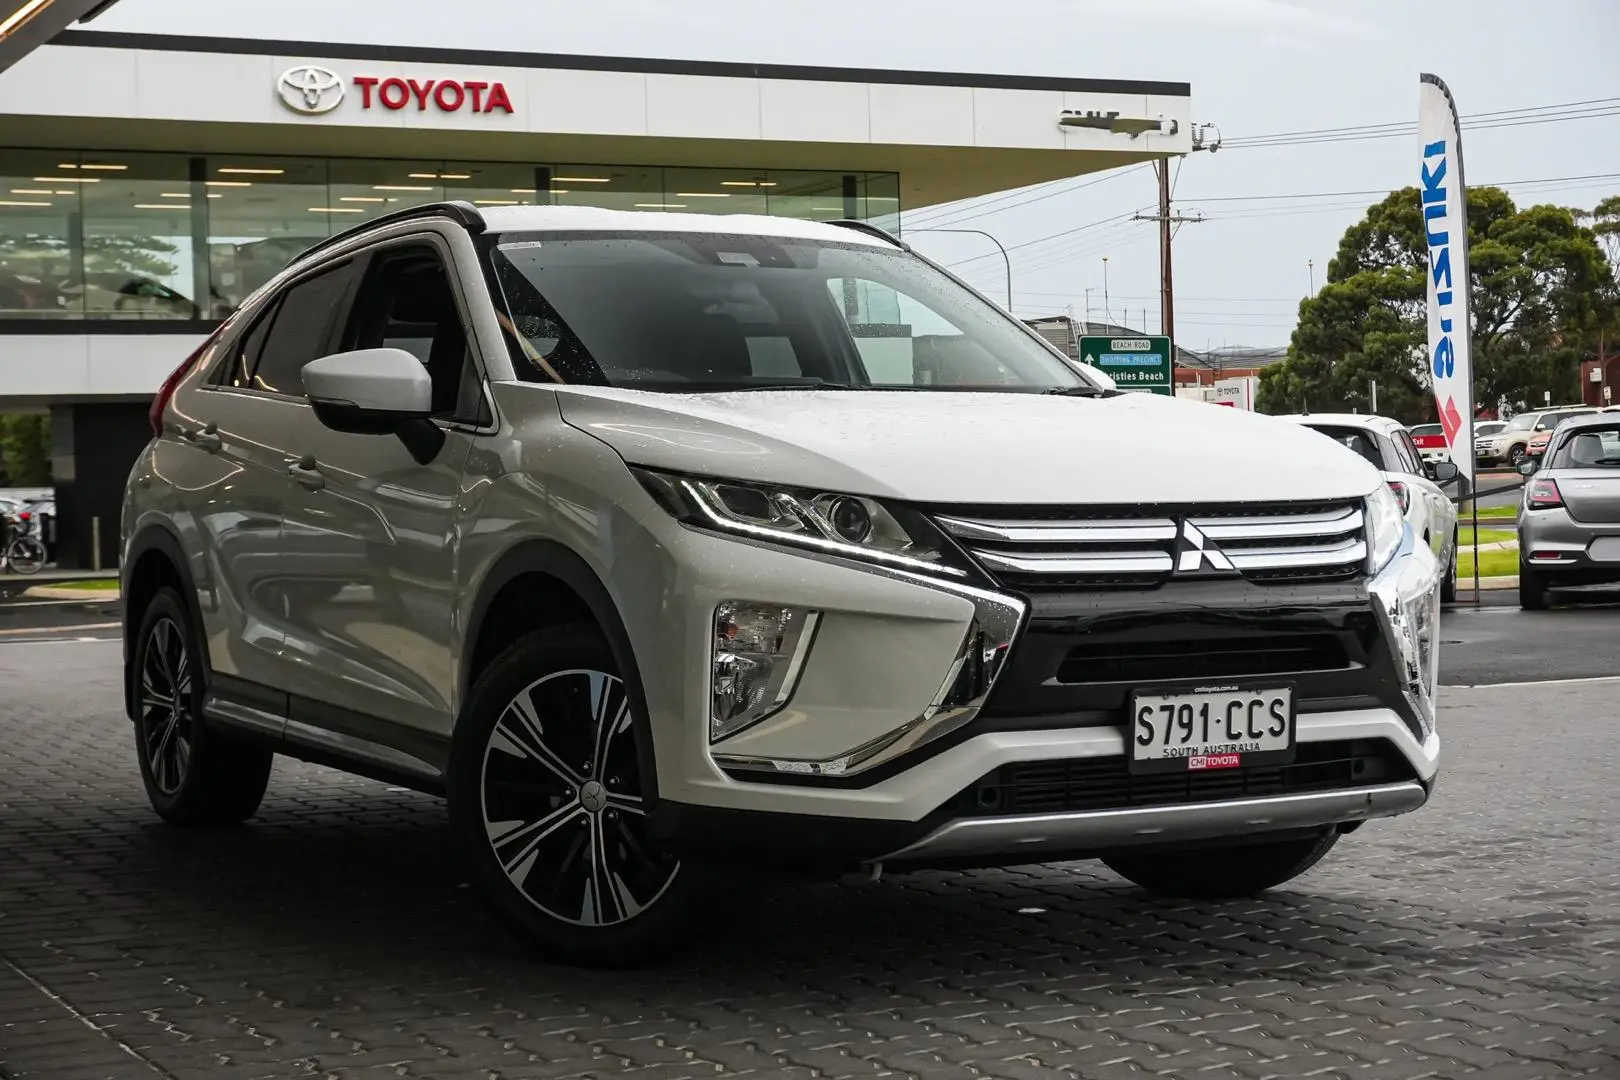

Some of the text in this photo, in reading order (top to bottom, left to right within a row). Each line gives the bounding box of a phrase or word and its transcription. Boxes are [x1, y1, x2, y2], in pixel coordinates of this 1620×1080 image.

[353, 76, 514, 114] TOYOTA
[1112, 341, 1150, 349] BEACH ROAD
[1109, 371, 1164, 380] risties Beach
[1163, 742, 1261, 757] SOUTH AUSTRALIA
[1190, 755, 1239, 767] CMI TOYOTA
